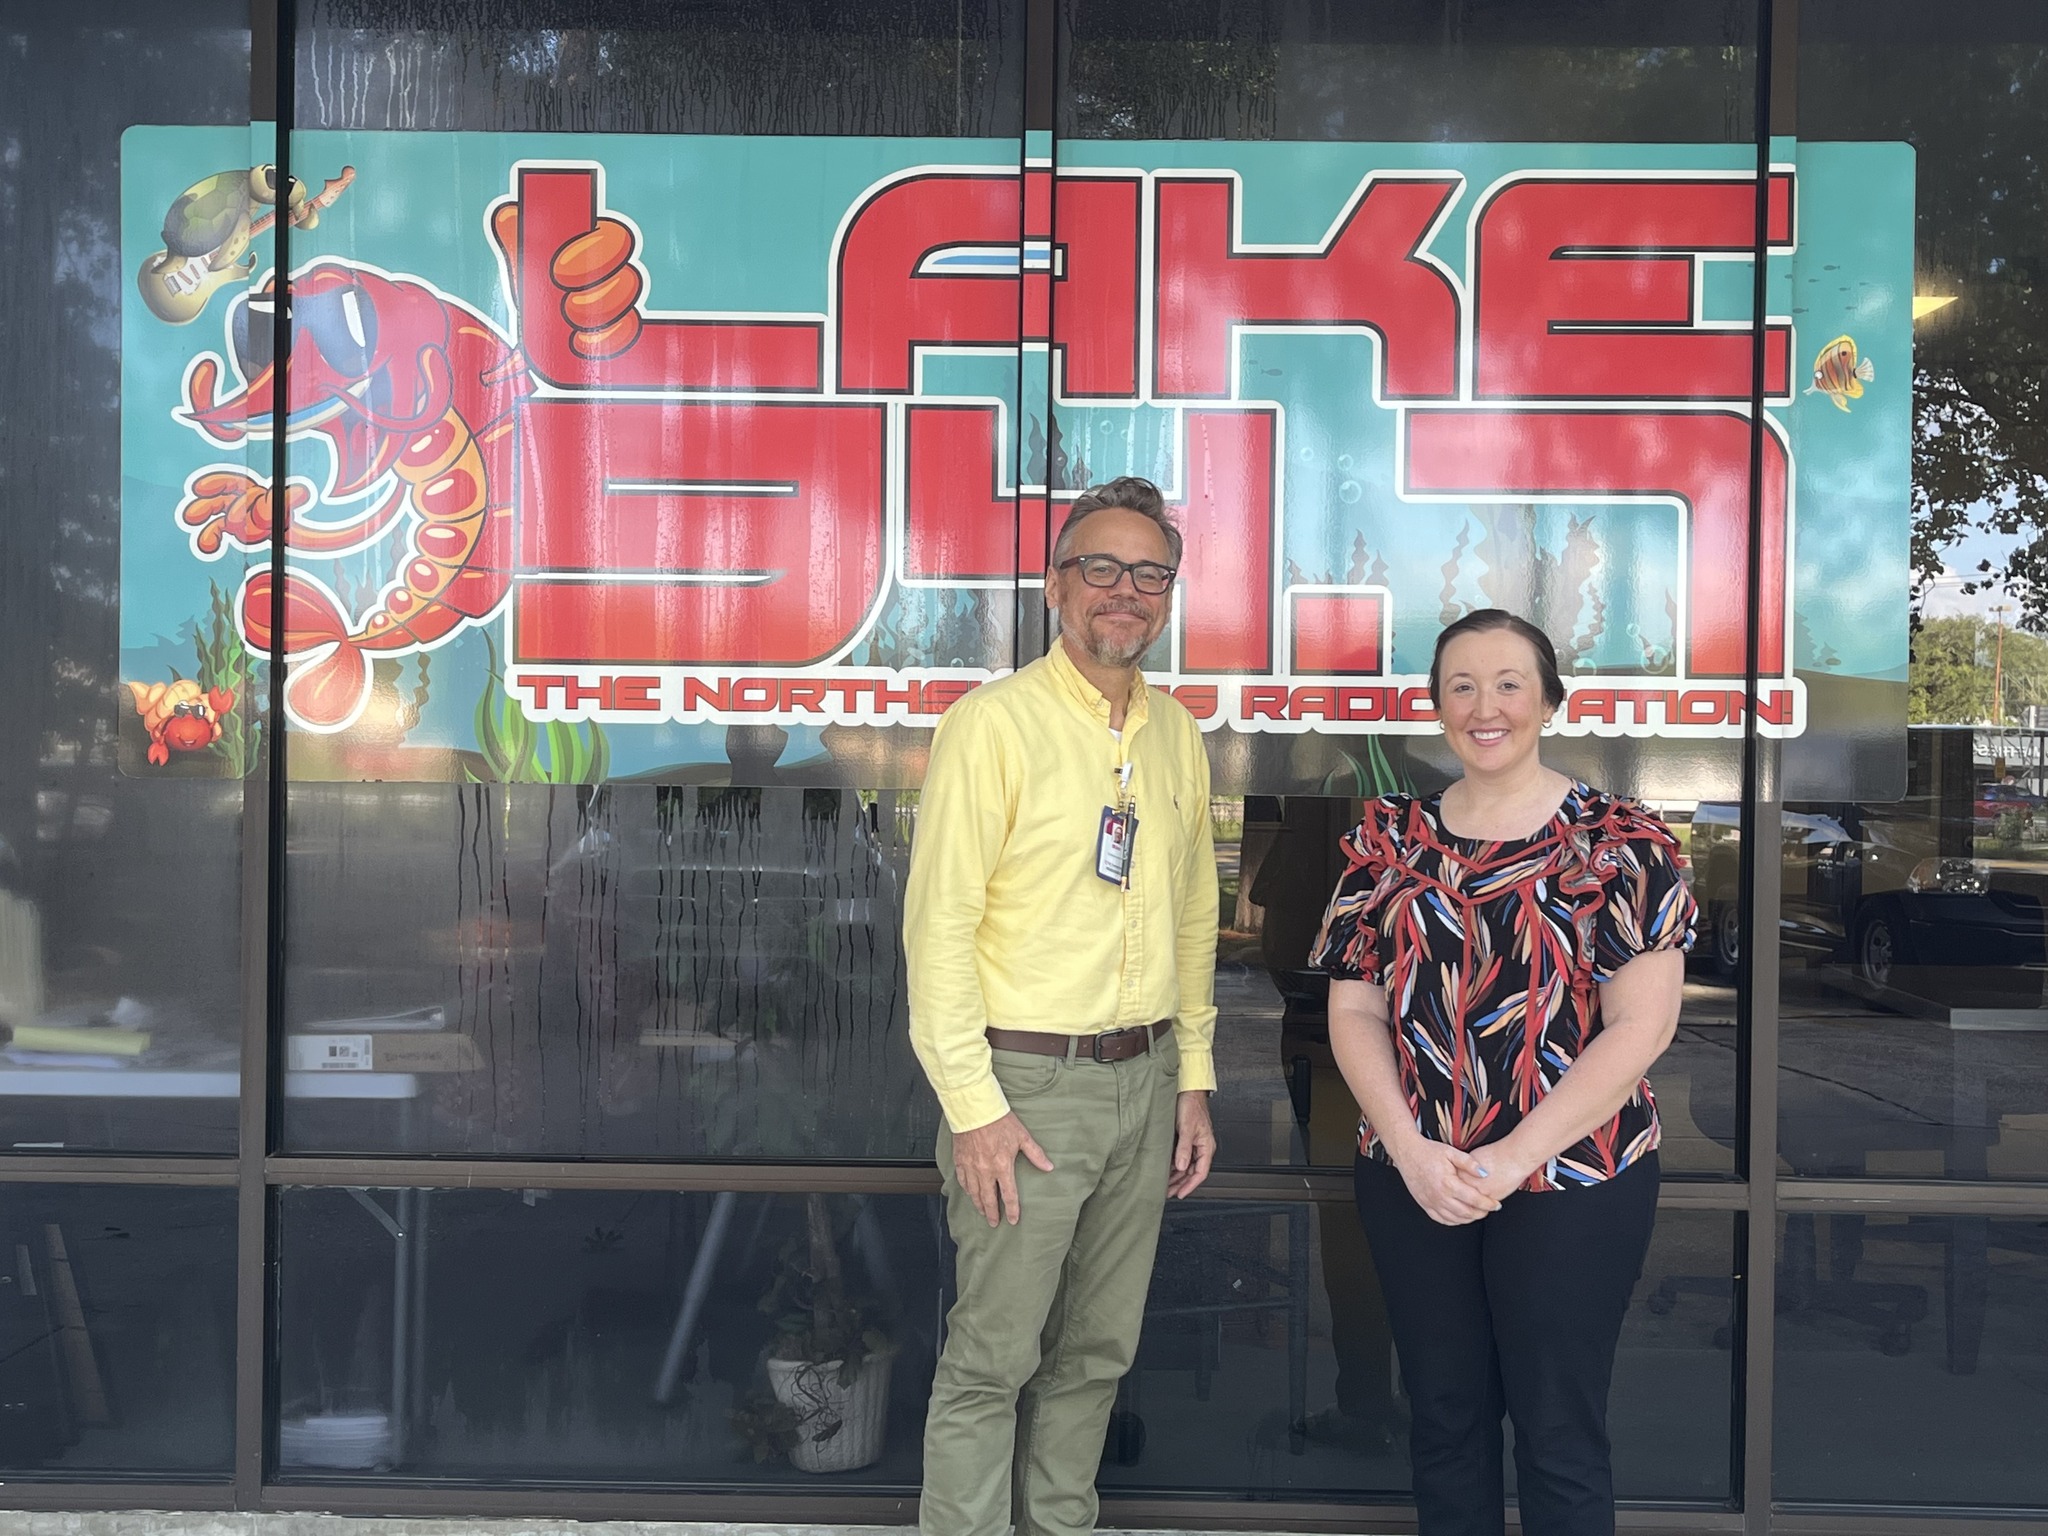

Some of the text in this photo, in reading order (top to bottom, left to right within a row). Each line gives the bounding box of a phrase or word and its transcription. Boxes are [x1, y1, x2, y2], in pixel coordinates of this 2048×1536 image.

[517, 166, 1797, 402] LAKE
[513, 398, 1790, 680] 94.7
[517, 675, 661, 711] THE
[683, 677, 1218, 720] NORTHSS
[1564, 689, 1794, 726] ATION!
